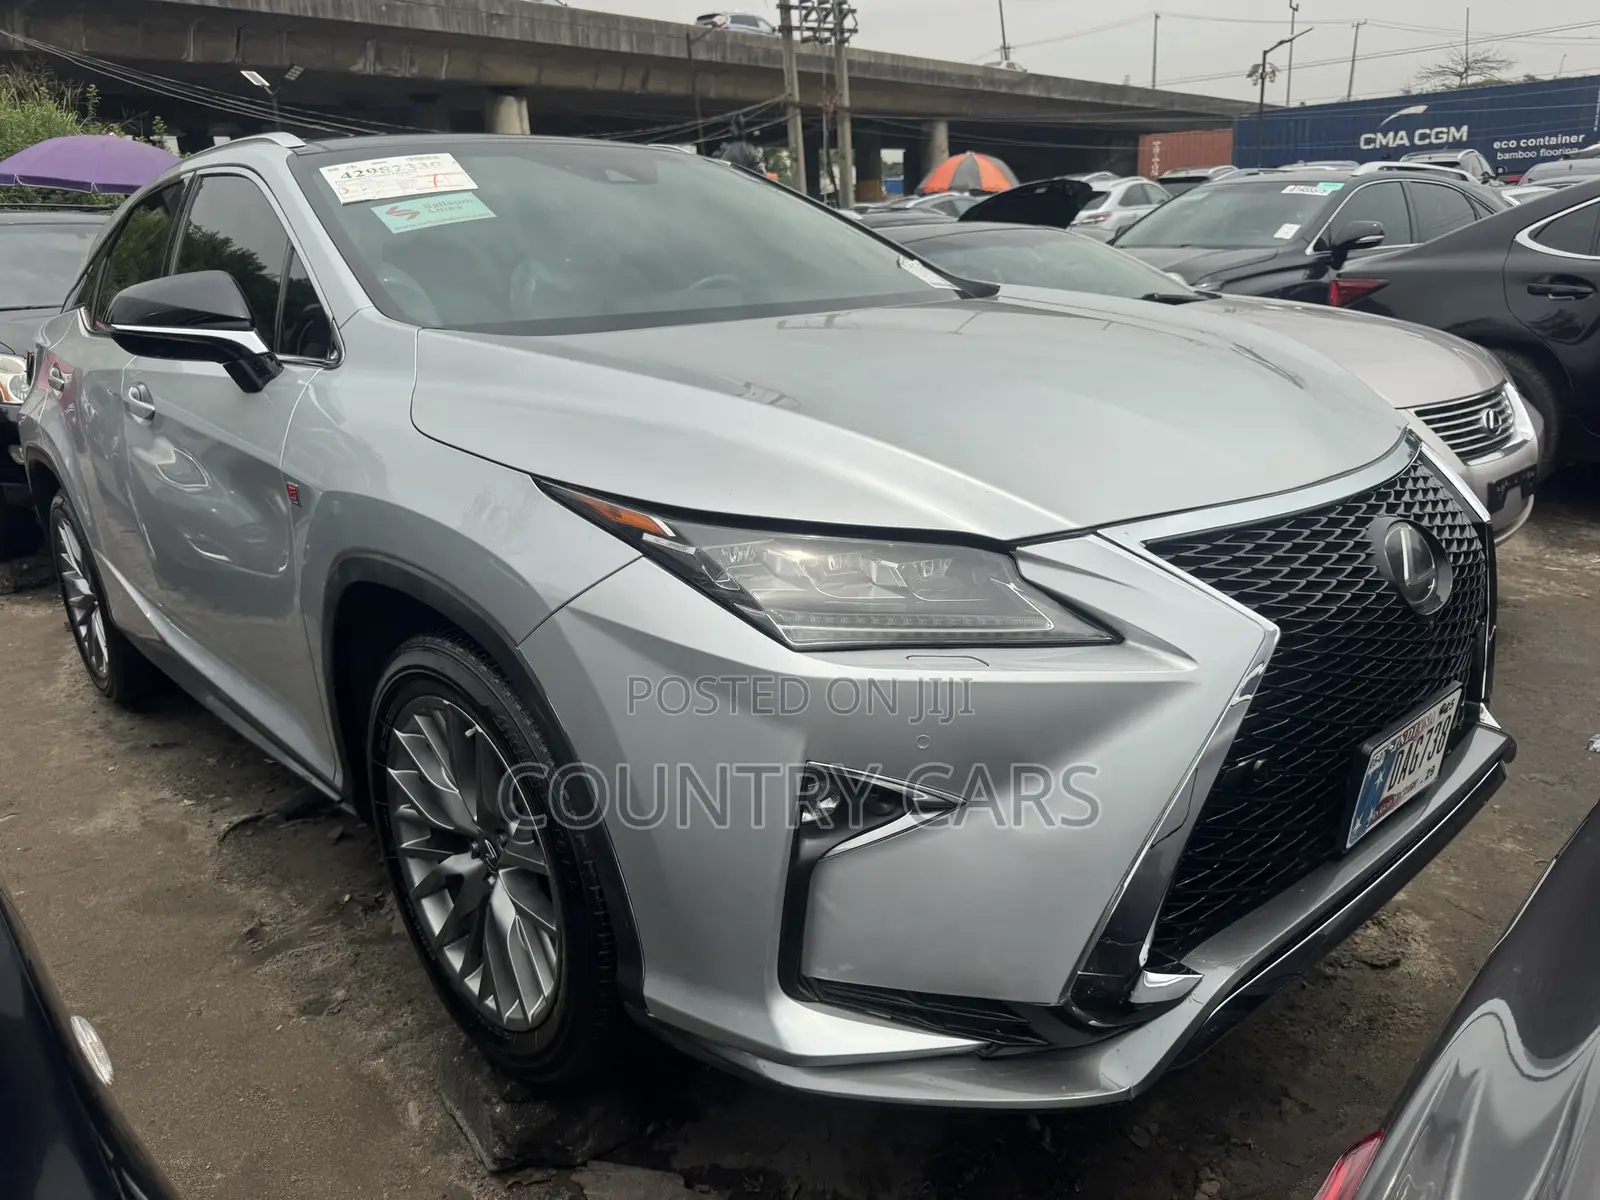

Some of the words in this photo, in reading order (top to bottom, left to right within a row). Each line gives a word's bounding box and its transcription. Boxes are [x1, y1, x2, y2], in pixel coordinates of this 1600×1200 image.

[1359, 130, 1410, 149] CMA
[1414, 125, 1469, 145] CGM
[1493, 139, 1518, 149] eco
[1519, 133, 1586, 148] container
[1496, 149, 1537, 161] bamboo
[1387, 713, 1452, 792] DAG738
